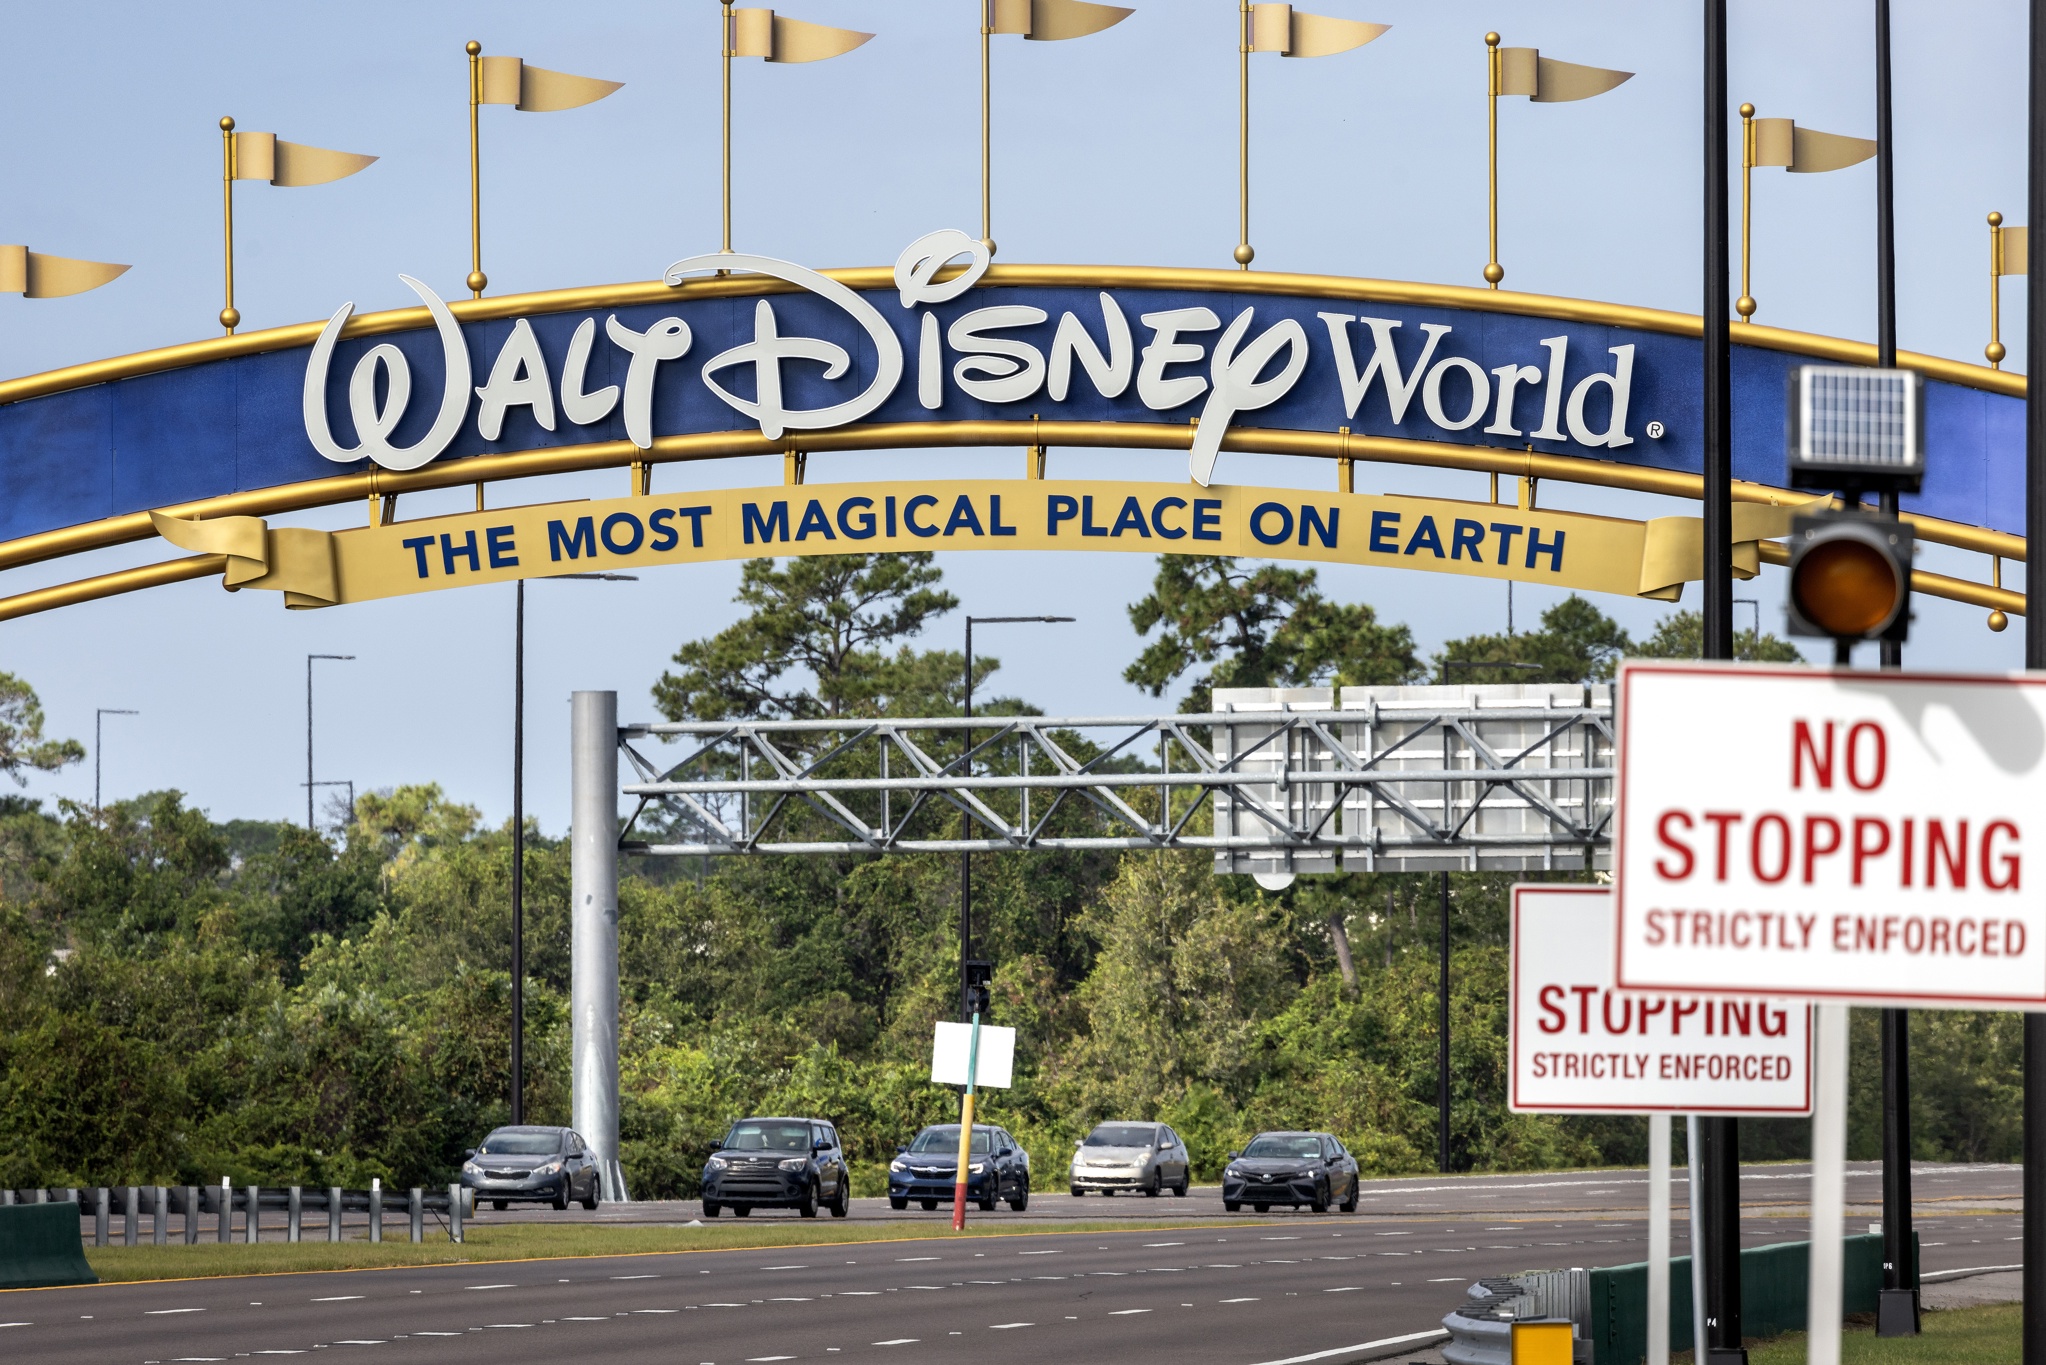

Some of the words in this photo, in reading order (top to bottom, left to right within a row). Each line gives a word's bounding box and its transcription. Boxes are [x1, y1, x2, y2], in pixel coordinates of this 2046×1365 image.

[1316, 311, 1635, 448] World
[403, 525, 519, 578] THE
[547, 506, 711, 561] MOST
[742, 495, 1016, 544] MAGICAL
[1047, 495, 1222, 541] PLACE
[1249, 502, 1339, 548] ON
[1369, 511, 1565, 572] EARTH
[1791, 718, 1888, 793] NO
[1654, 808, 2022, 892] STOPPING
[1646, 909, 1817, 950] STRICTLY
[1832, 914, 2027, 957] ENFORCED
[1538, 984, 1787, 1037] STOPPING
[1533, 1053, 1649, 1079] STRICTLY
[1660, 1054, 1791, 1080] ENFORCED
